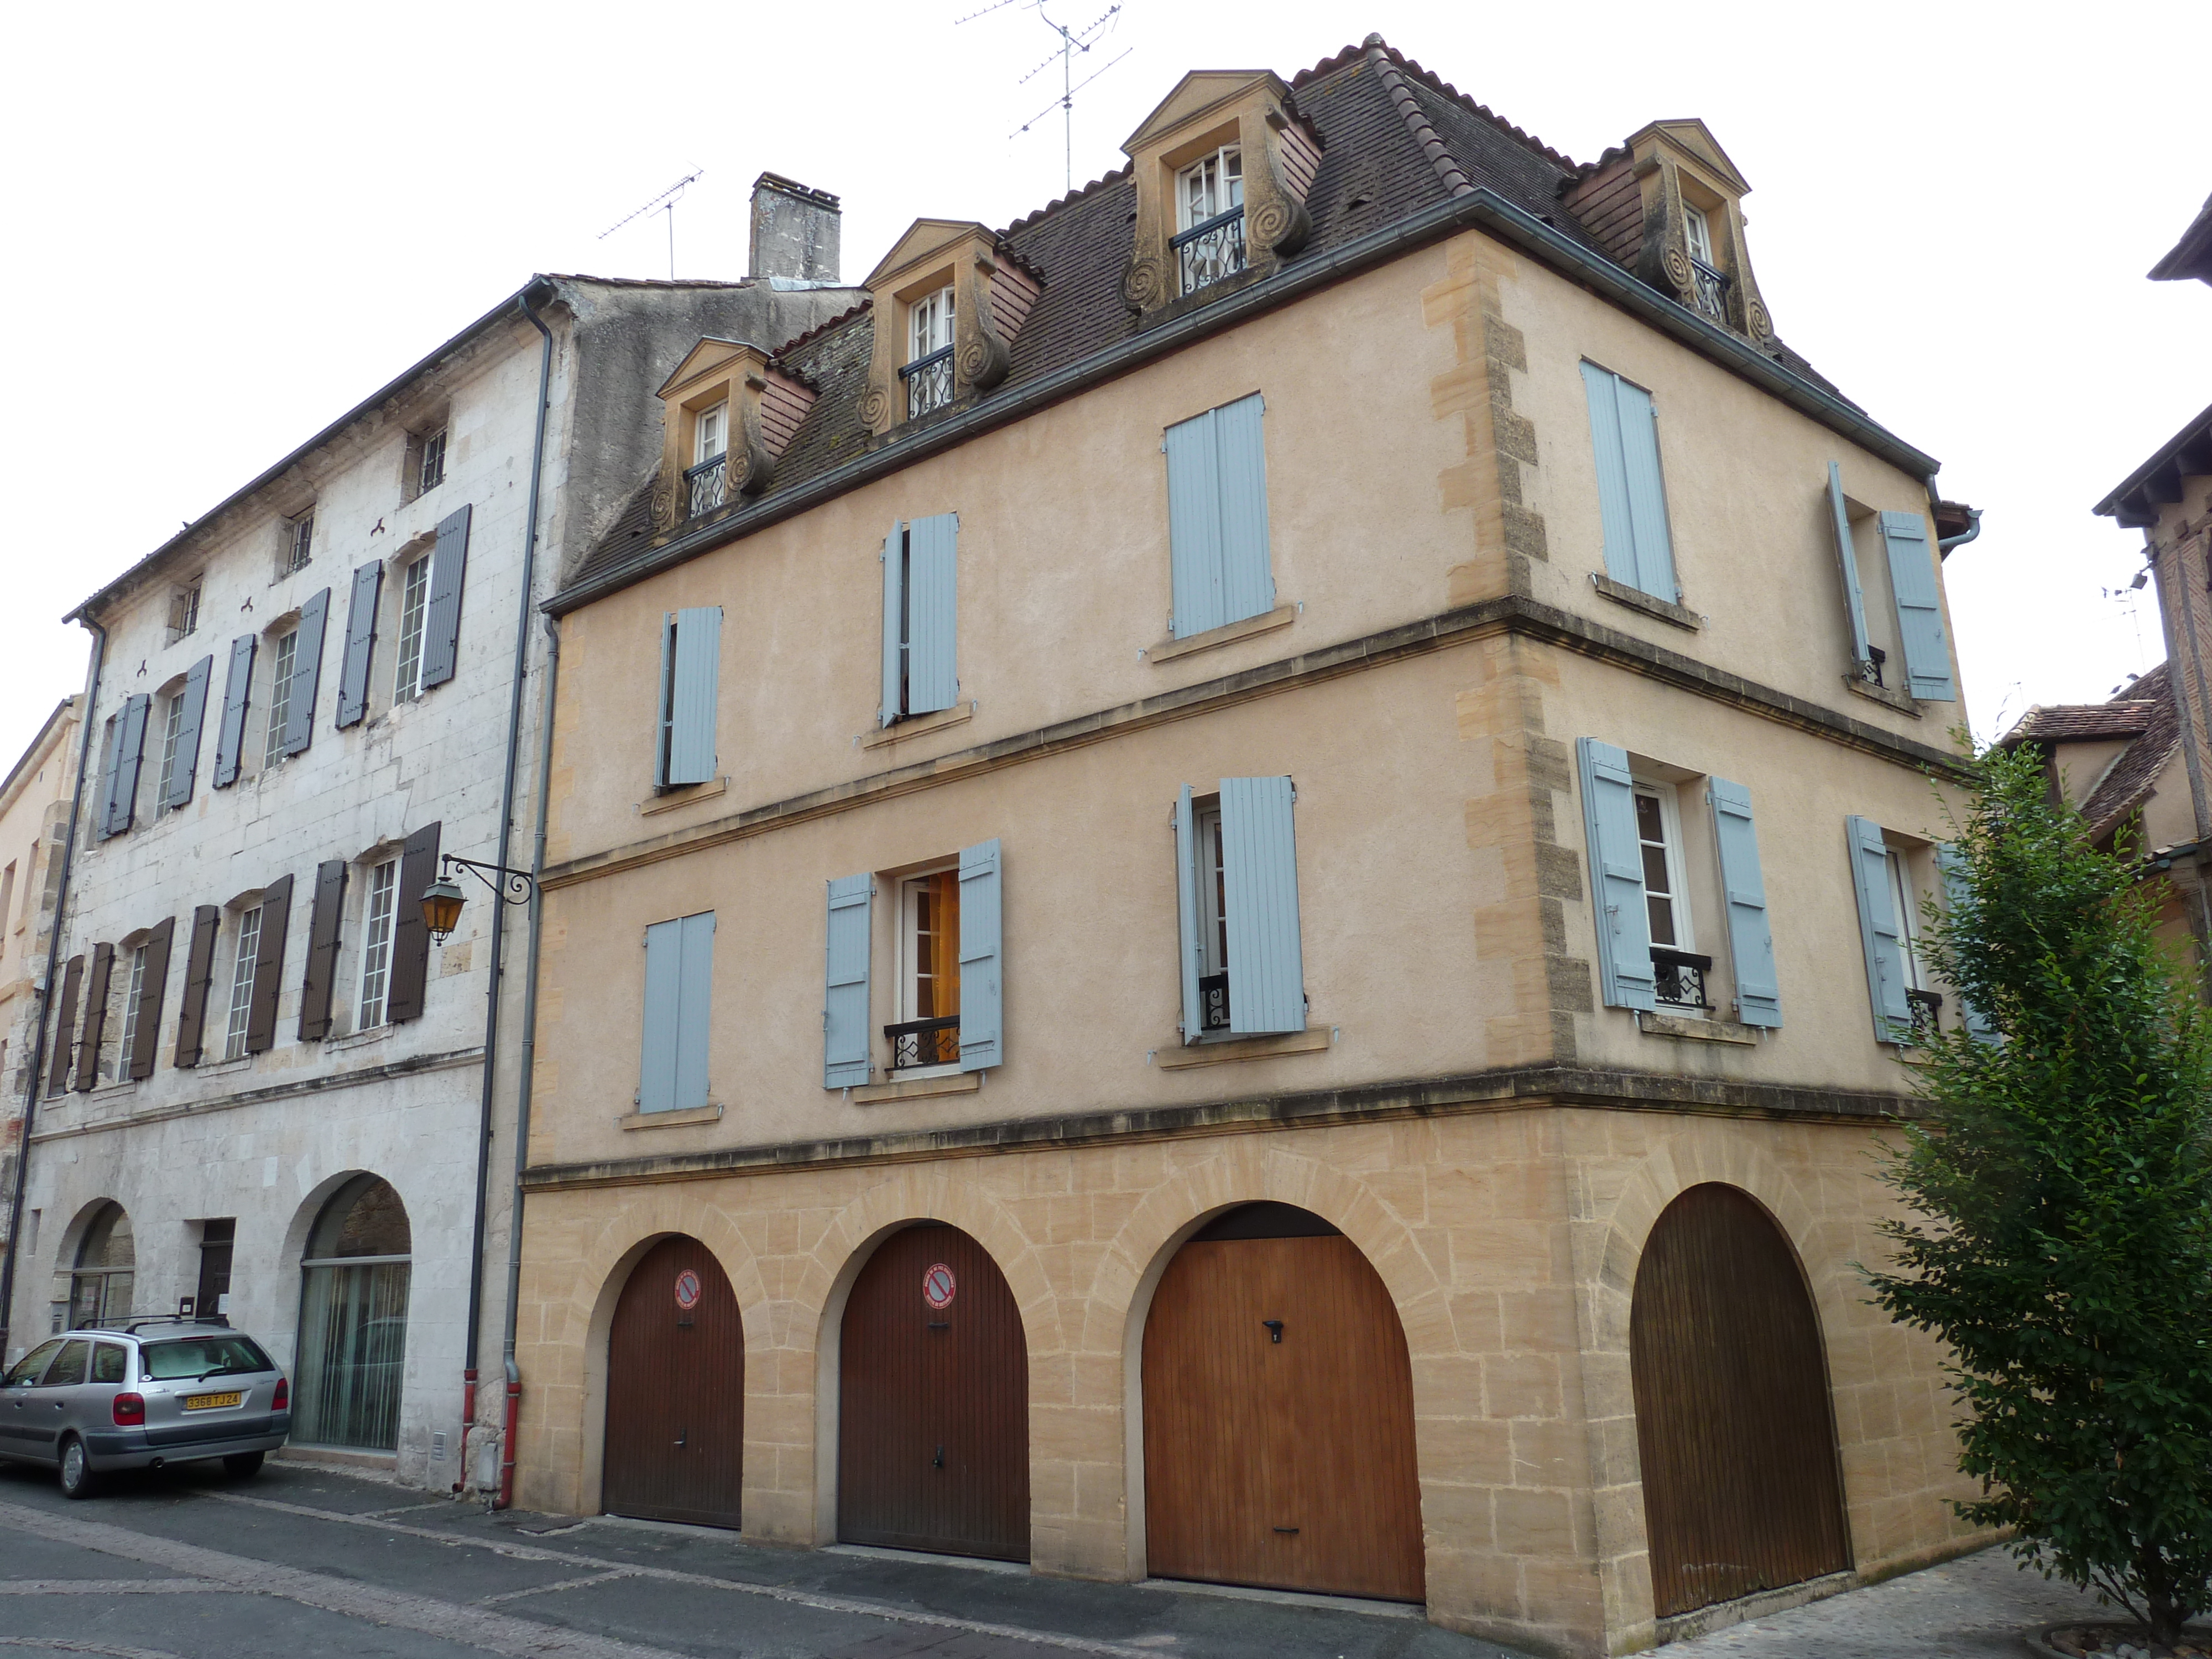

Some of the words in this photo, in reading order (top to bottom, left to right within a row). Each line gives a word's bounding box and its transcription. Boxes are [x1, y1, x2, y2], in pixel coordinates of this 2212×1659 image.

[188, 1397, 211, 1408] 3368
[213, 1396, 225, 1406] TJ
[227, 1394, 238, 1404] 24
